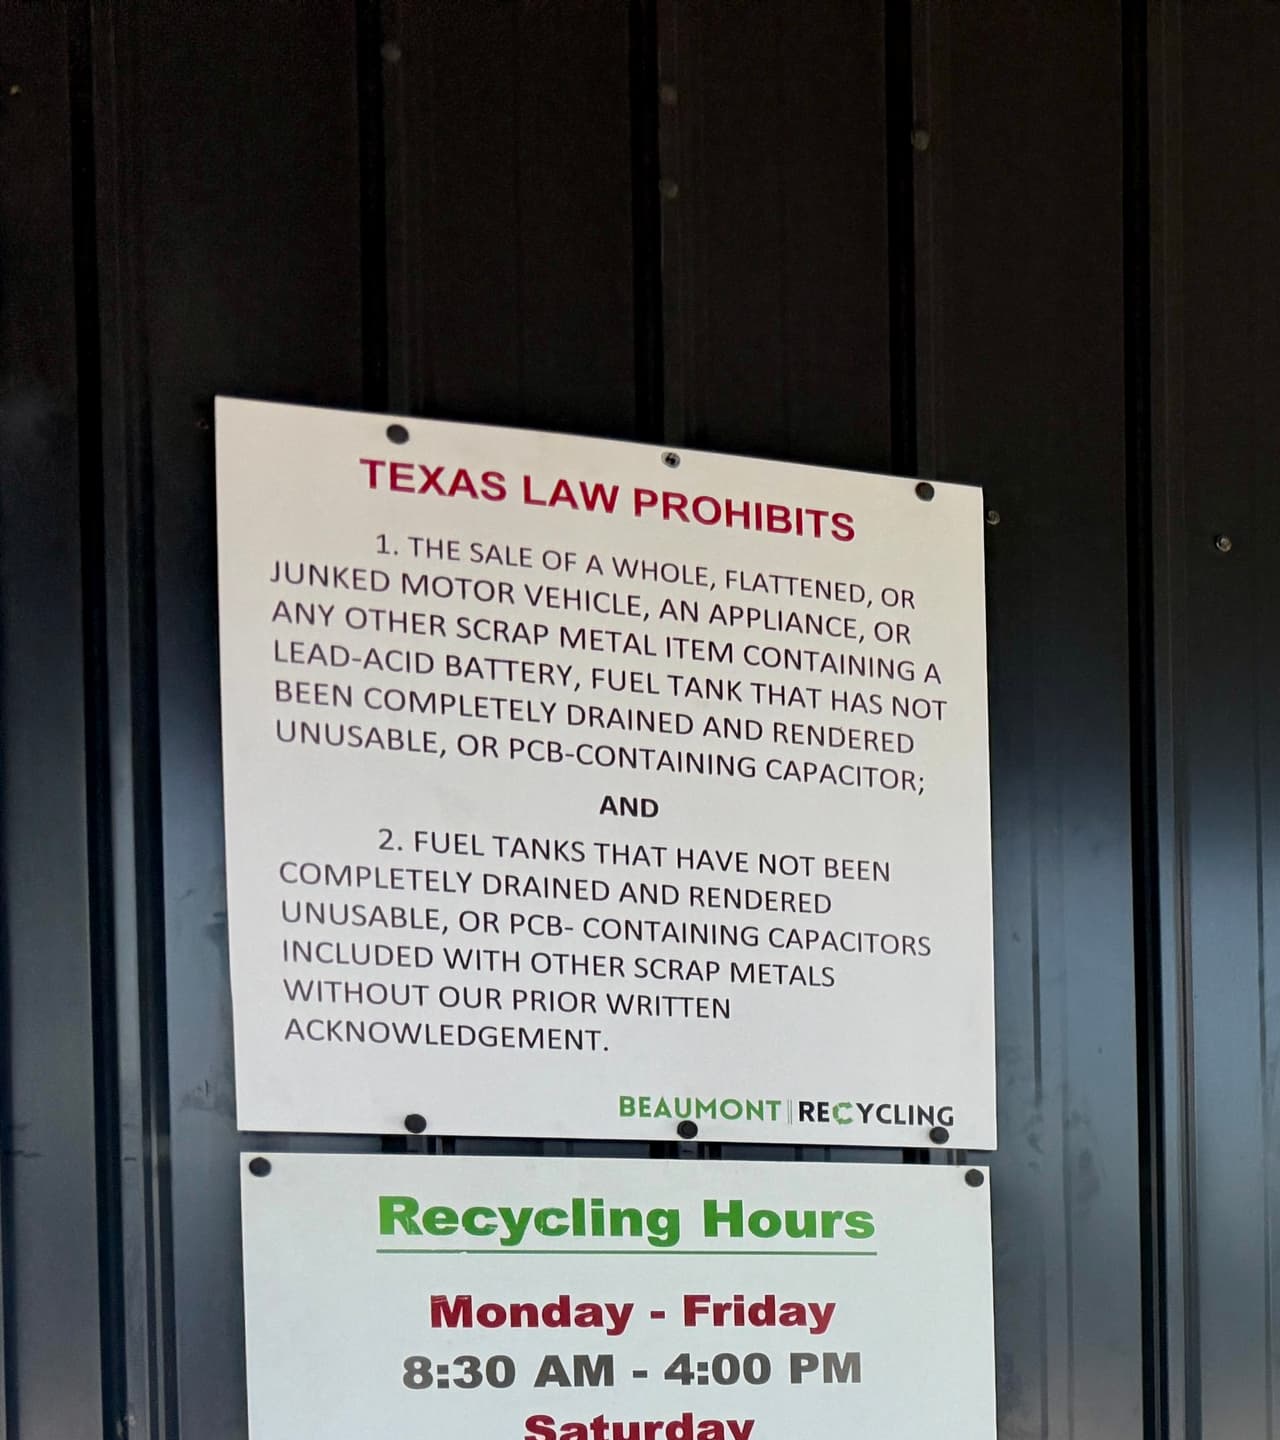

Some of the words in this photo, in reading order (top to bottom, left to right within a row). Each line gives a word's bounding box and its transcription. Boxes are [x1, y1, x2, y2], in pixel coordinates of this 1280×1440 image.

[359, 458, 507, 502] TEXAS
[523, 475, 620, 514] LAW
[634, 488, 855, 542] PROHIBITS
[376, 534, 398, 556] 1.
[407, 536, 460, 561] THE
[470, 542, 532, 569] SALE
[542, 550, 577, 572] OF
[585, 554, 604, 575] A
[612, 556, 716, 591] WHOLE,
[726, 569, 873, 609] FLATTENED,
[881, 587, 915, 610] OR
[270, 561, 390, 592] JUNKED
[402, 572, 515, 605] MOTOR
[524, 583, 649, 622] VEHICLE,
[659, 598, 698, 623] AN
[708, 603, 865, 644] APPLIANCE,
[874, 621, 911, 645] OR
[378, 828, 402, 851] 2.
[415, 830, 485, 857] FUEL
[492, 835, 585, 863] TANKS
[593, 842, 668, 868] THAT
[677, 848, 749, 873] HAVE
[759, 853, 816, 877] NOT
[824, 857, 890, 882] BEEN
[285, 1018, 609, 1052] ACKNOWLEDGEMENT.
[619, 1095, 782, 1123] BEAUMONT
[798, 1100, 954, 1129] RECYCLING
[379, 1195, 680, 1247] Recycling
[703, 1199, 875, 1239] Hours
[430, 1294, 634, 1336] Monday
[683, 1294, 836, 1335] Friday
[403, 1355, 516, 1390] 8:30
[533, 1354, 614, 1388] AM
[664, 1352, 771, 1386] 4:00
[789, 1352, 861, 1384] PM
